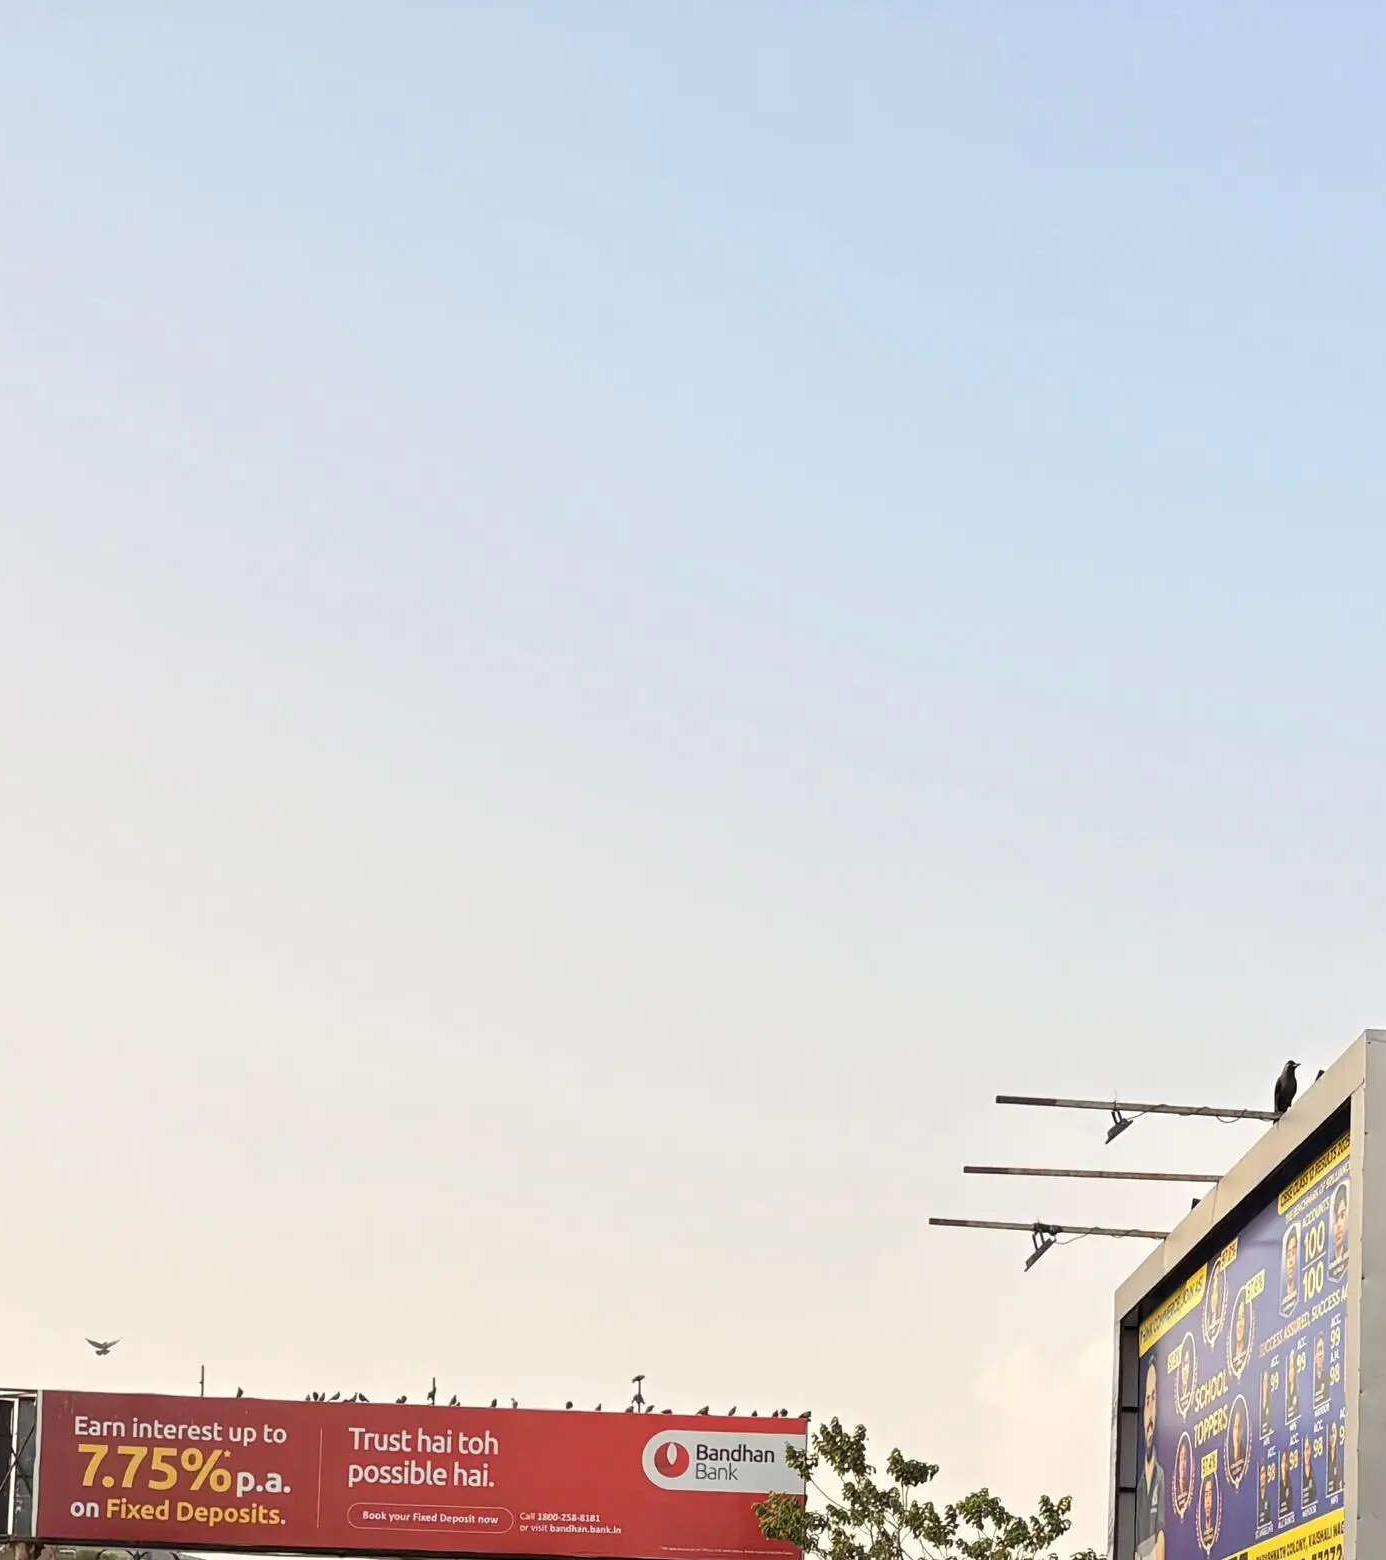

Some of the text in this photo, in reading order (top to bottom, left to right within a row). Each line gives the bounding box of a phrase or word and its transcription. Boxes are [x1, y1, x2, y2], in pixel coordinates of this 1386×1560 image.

[1304, 1221, 1325, 1257] 100
[1302, 1261, 1324, 1302] 100
[1330, 1324, 1340, 1349] 99
[1296, 1349, 1306, 1375] 99
[1194, 1369, 1229, 1412] SCHOOL
[1270, 1370, 1278, 1392] 99
[74, 1416, 288, 1447] Earn interest up to
[1193, 1404, 1229, 1448] TOPPERS
[348, 1427, 499, 1455] Trust hai toh
[1313, 1435, 1322, 1459] 98
[348, 1461, 495, 1488] possible hai.
[696, 1444, 775, 1480] Bandhan Bank
[237, 1471, 291, 1498] p.a.
[70, 1498, 286, 1527] on Fixed Deposits.
[363, 1511, 499, 1525] Book your Fixed Deposit now
[519, 1512, 536, 1521] Call
[530, 1523, 547, 1532] visit
[549, 1524, 622, 1534] bandhan.bank.in
